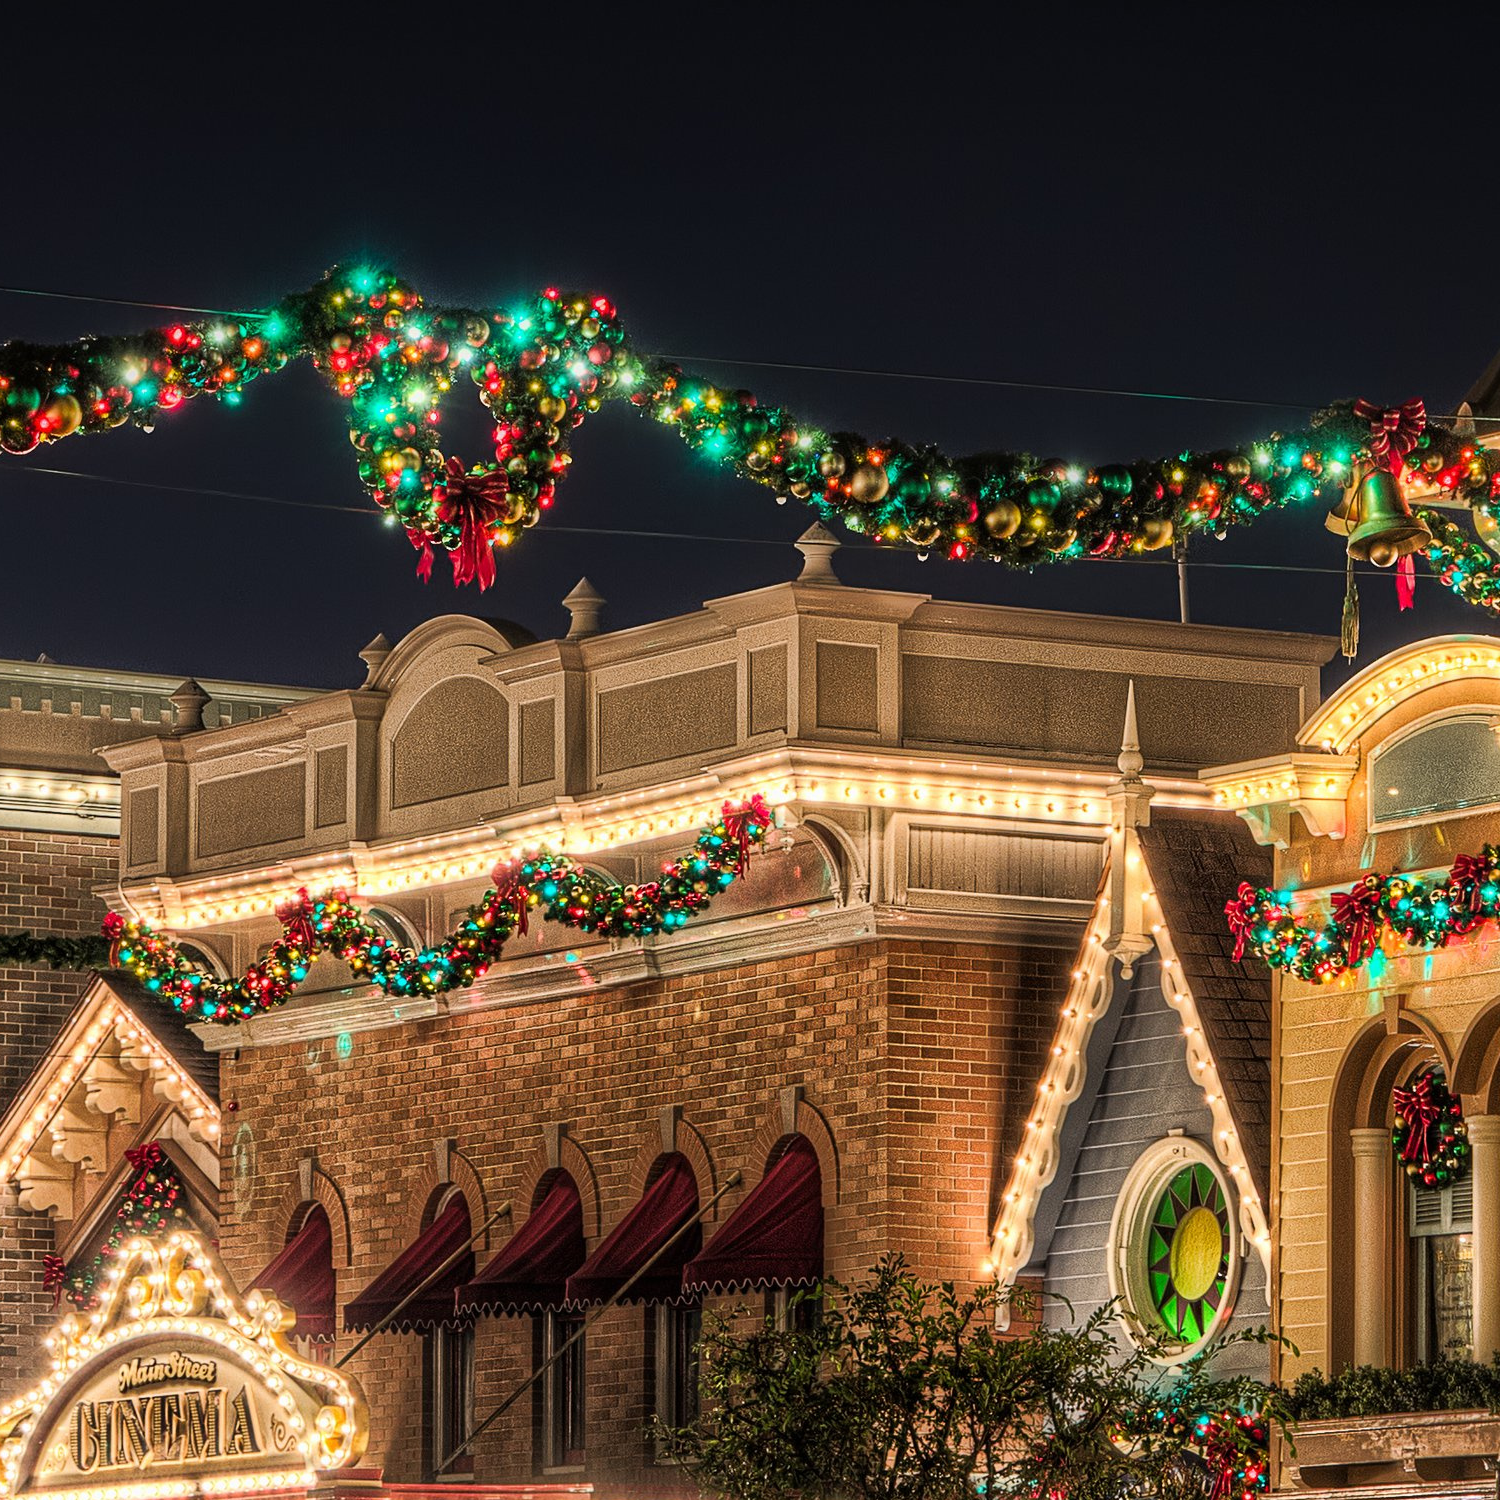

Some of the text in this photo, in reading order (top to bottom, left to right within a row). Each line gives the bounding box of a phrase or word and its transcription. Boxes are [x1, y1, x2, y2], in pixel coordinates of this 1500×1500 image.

[118, 1350, 217, 1393] Main Street
[69, 1384, 264, 1475] CINEMA
